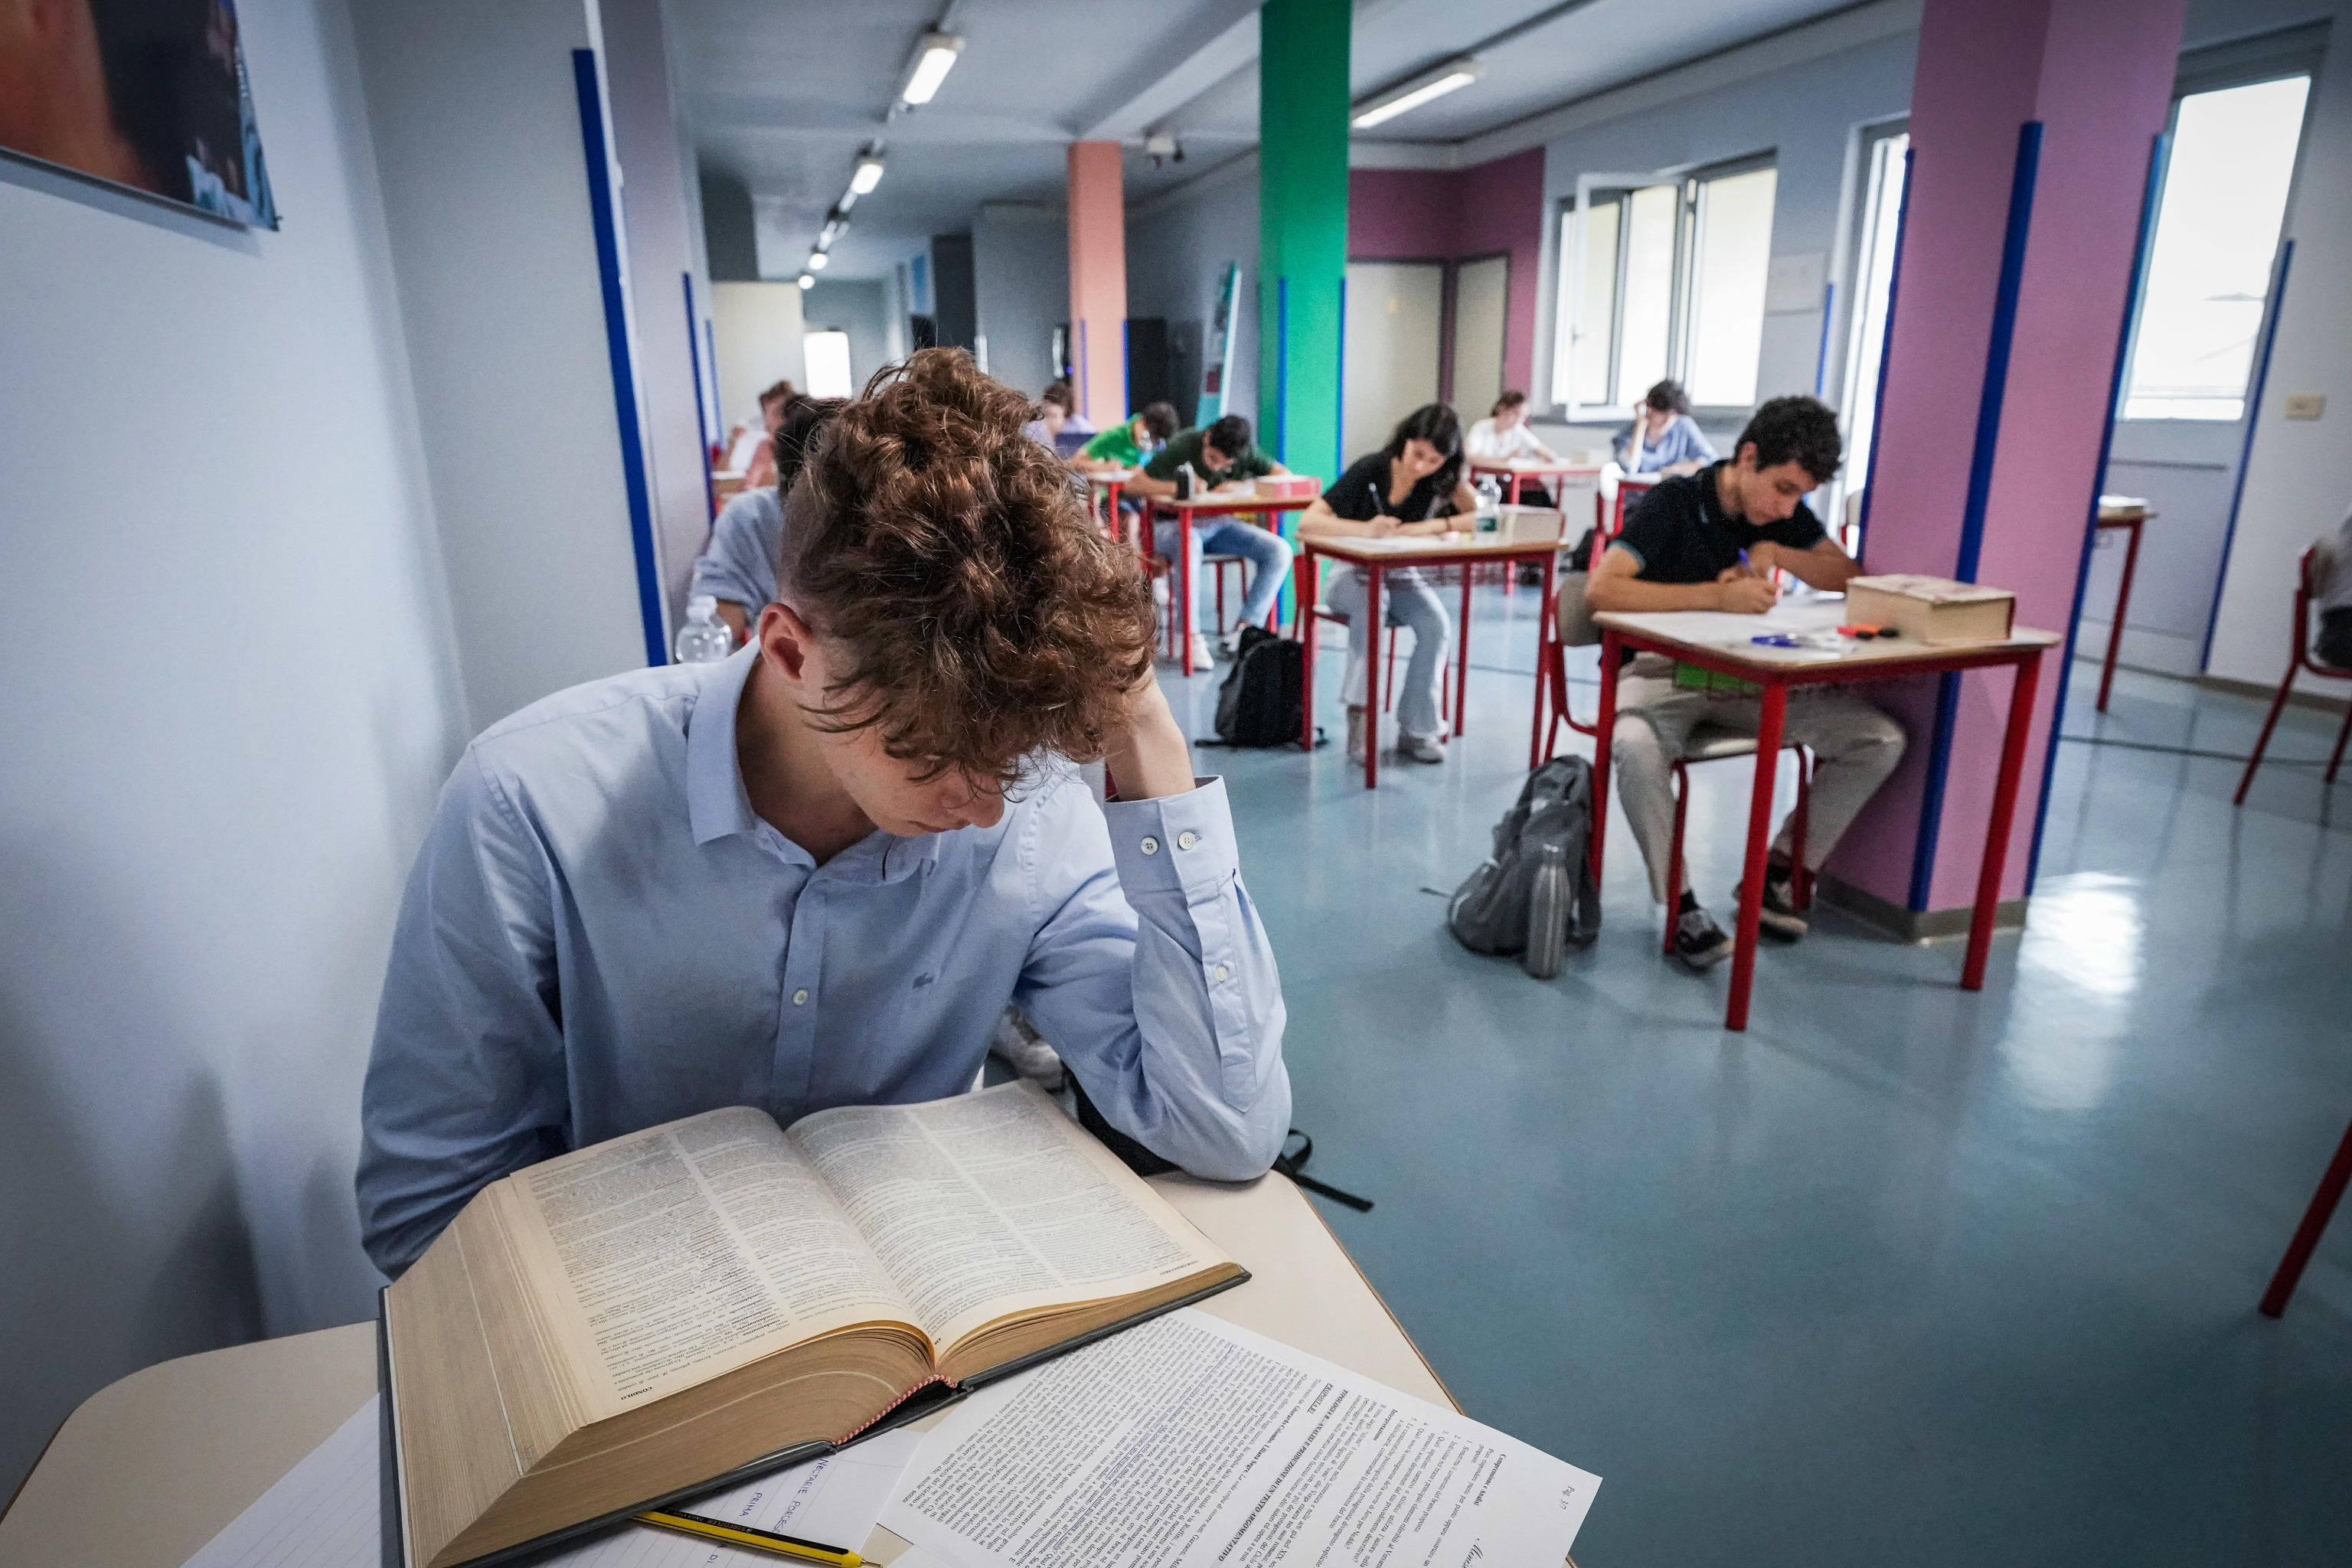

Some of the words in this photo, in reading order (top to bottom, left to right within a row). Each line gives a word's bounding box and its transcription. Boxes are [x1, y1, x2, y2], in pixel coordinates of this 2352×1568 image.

[1328, 1390, 1348, 1415] TIPOLOGIA
[1307, 1422, 1323, 1442] ANALISI
[1280, 1446, 1306, 1478] PRODUZIONE
[1255, 1494, 1271, 1512] TESTO
[1218, 1512, 1256, 1561] ARGOMENTATIVO
